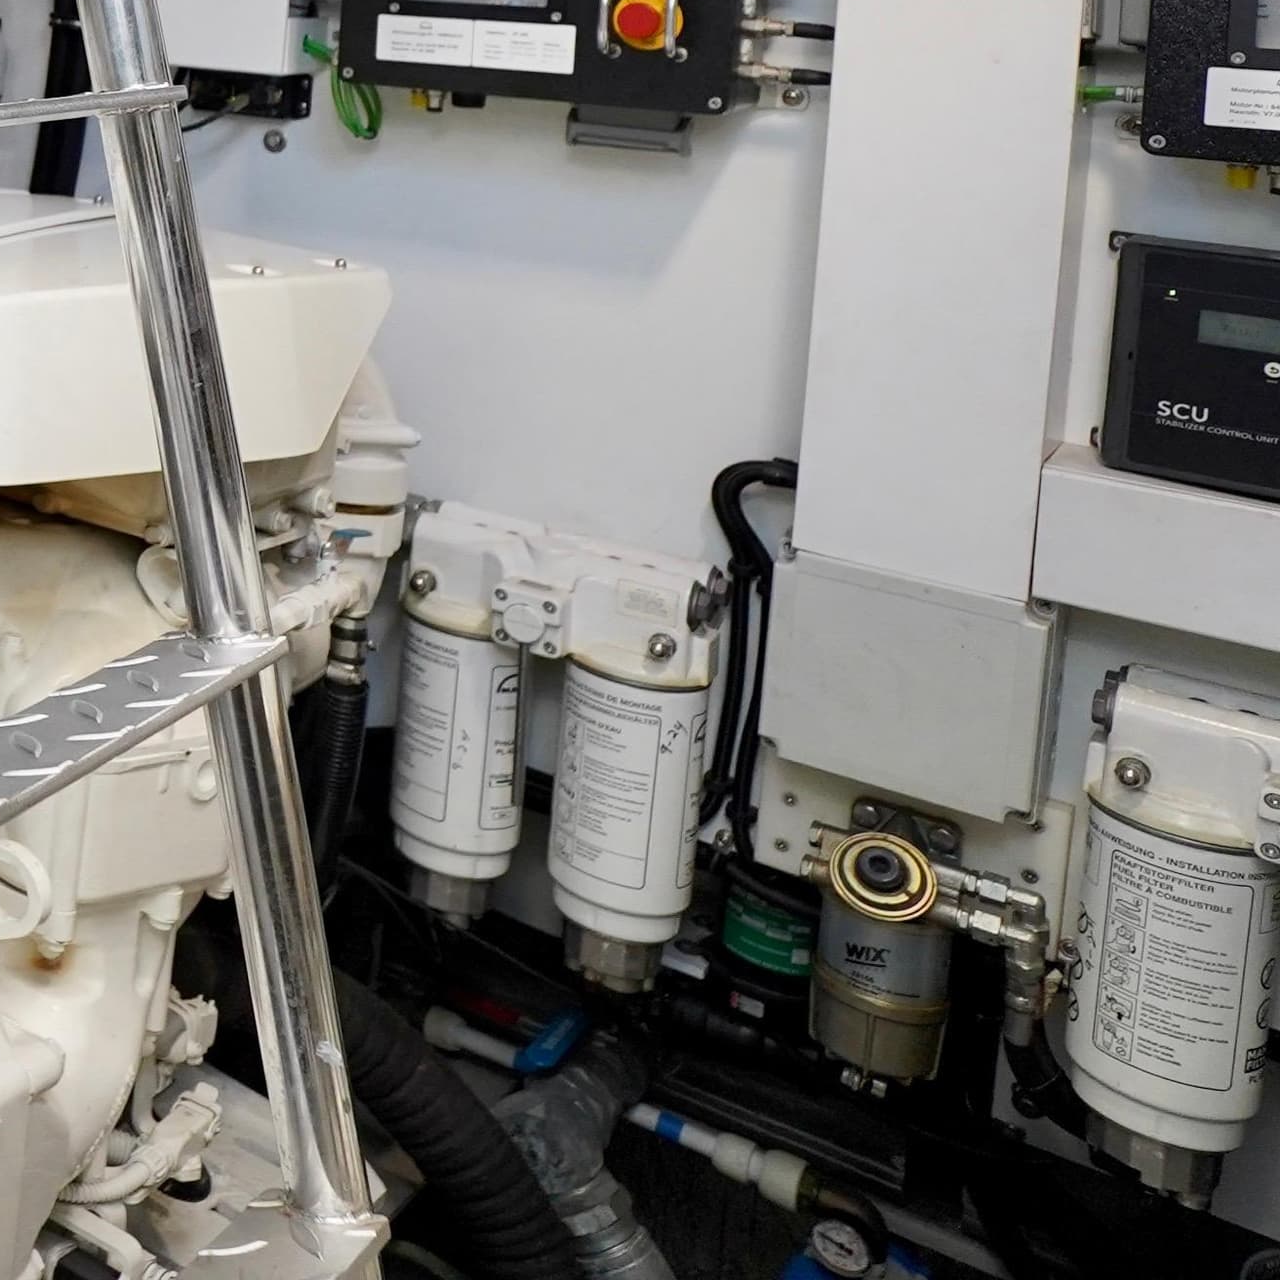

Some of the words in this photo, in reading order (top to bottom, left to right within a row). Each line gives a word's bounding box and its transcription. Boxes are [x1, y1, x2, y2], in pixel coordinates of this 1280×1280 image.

[1156, 400, 1209, 423] SCU
[1155, 417, 1206, 432] STABILIZER
[1206, 426, 1254, 441] CONTROL
[1255, 434, 1279, 445] UNIT
[1113, 862, 1136, 879] FUEL
[1139, 873, 1174, 892] FILTER
[1166, 856, 1244, 881] INSTALLATION
[1112, 871, 1143, 892] FILTRE
[1156, 889, 1233, 915] COMBUSTIBLE
[845, 941, 889, 963] WIX
